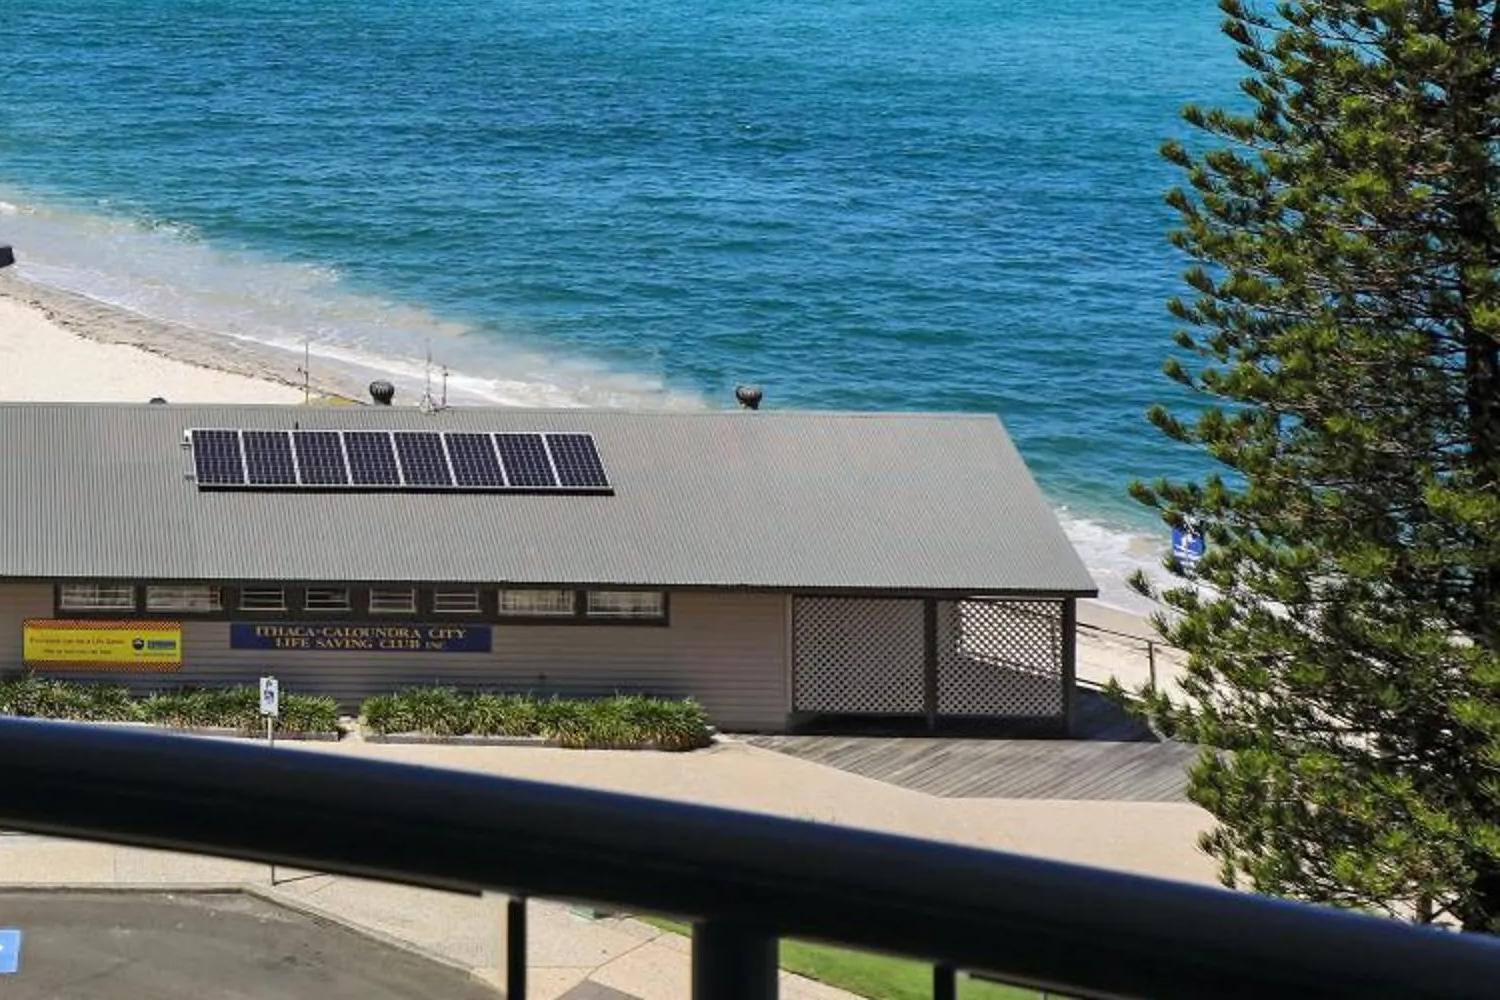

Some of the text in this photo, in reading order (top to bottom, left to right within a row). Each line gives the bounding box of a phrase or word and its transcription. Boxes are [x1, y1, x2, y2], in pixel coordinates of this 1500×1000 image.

[428, 627, 467, 639] CITY
[276, 637, 309, 648] LIFE
[316, 638, 373, 649] SAVING
[380, 639, 420, 649] CLUB
